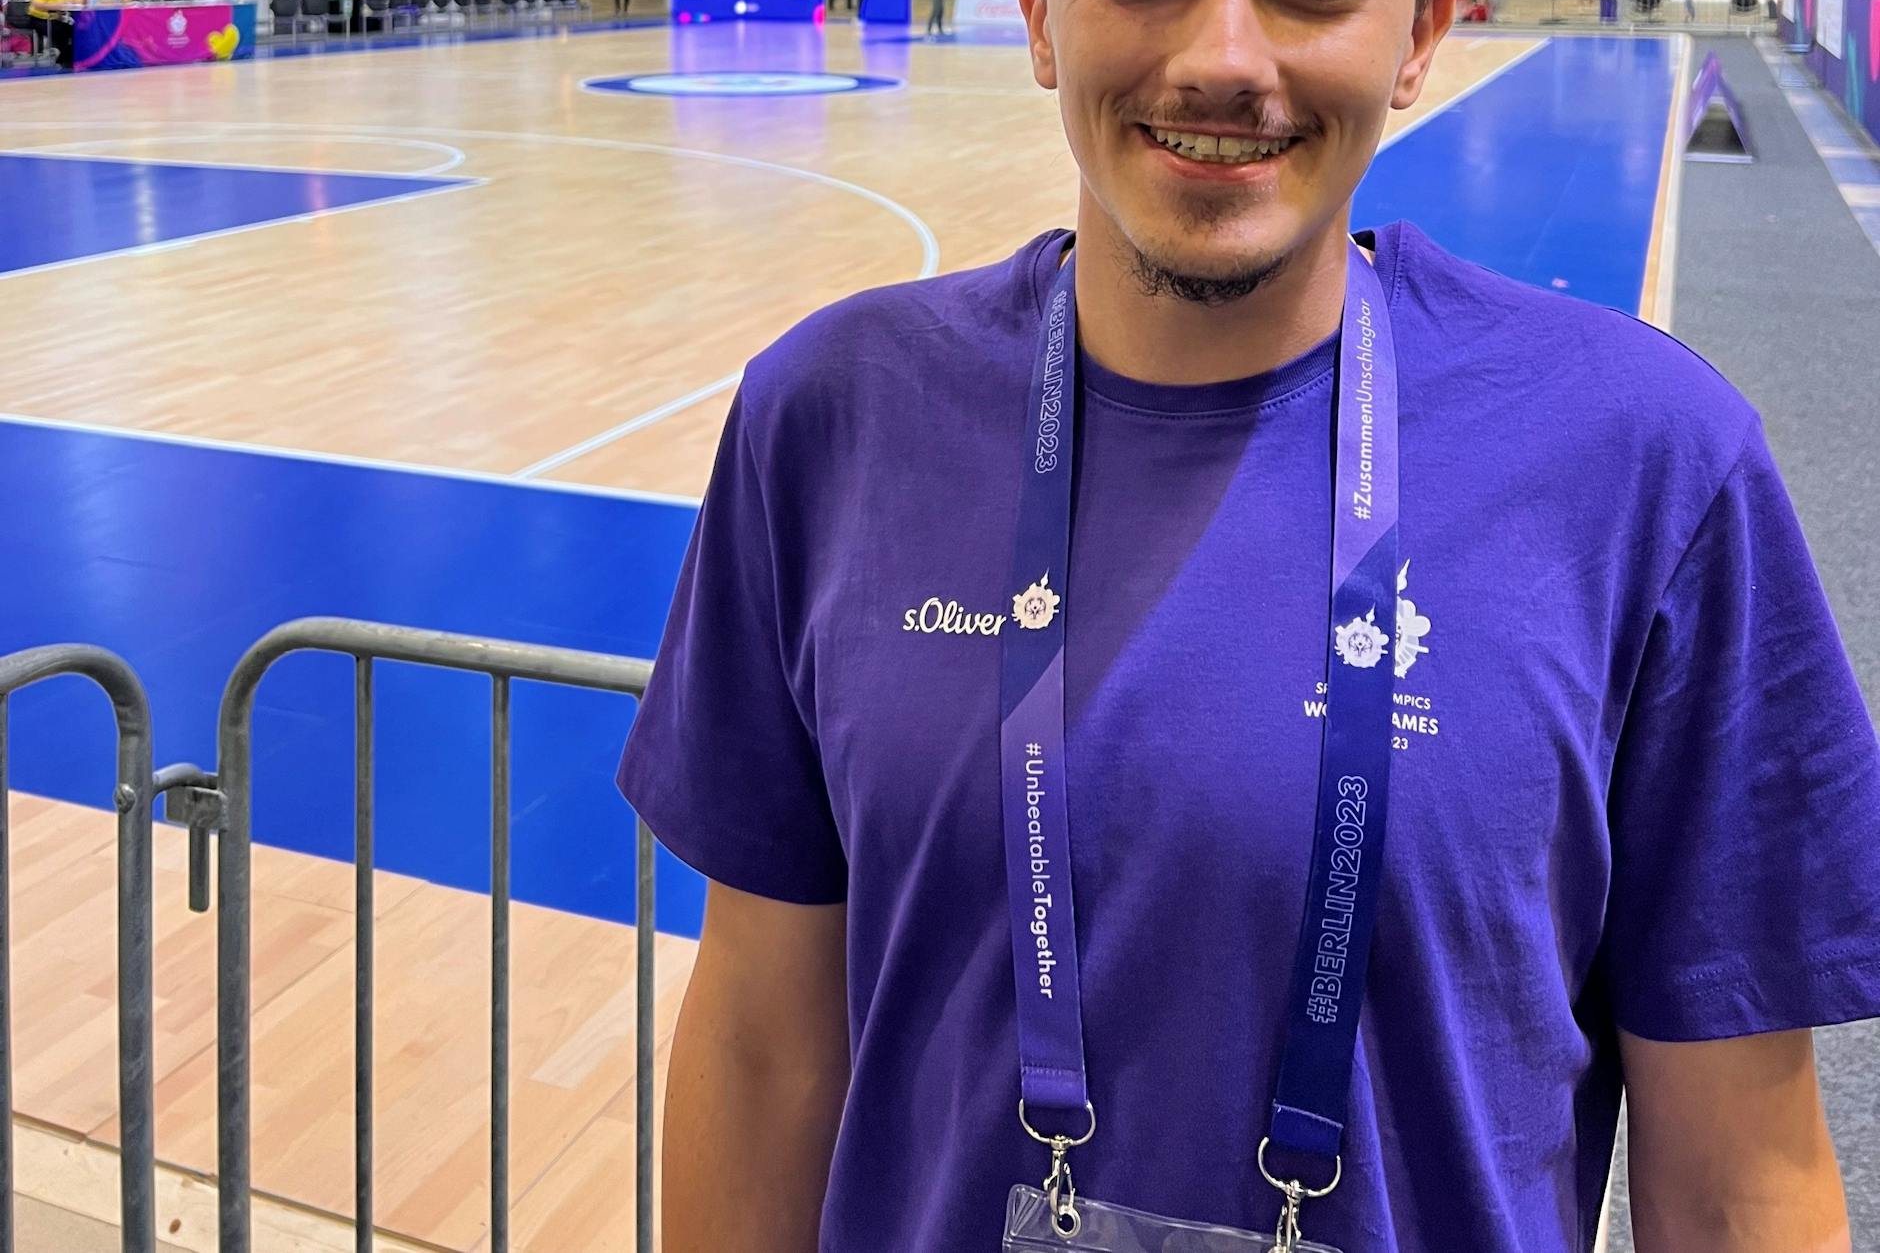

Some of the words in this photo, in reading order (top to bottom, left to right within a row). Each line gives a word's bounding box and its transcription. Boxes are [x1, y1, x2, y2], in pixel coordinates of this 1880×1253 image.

[1035, 289, 1068, 474] #BERLIN2023
[1353, 297, 1377, 520] #ZusammenUnschlagbar
[903, 597, 1007, 636] s.Oliver
[1391, 711, 1439, 735] AMES
[1391, 736, 1409, 750] 23
[1392, 692, 1432, 710] MPICS
[1025, 742, 1057, 999] #UnbeatableTogether
[1306, 775, 1368, 1024] #BERLIN2023
